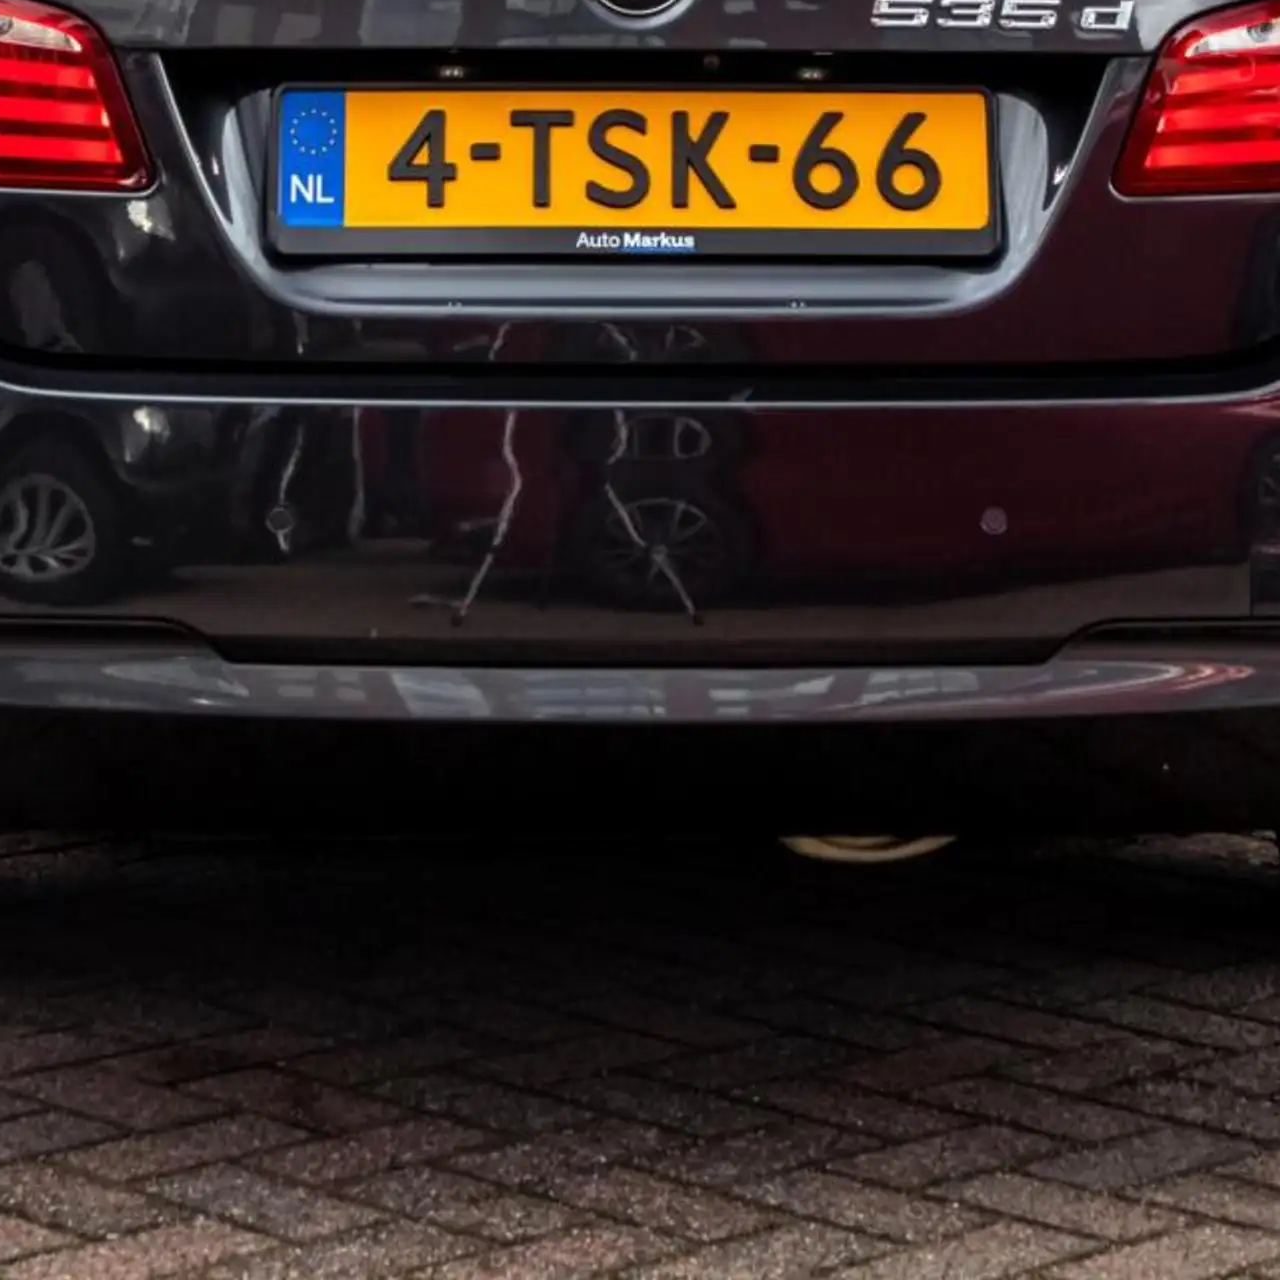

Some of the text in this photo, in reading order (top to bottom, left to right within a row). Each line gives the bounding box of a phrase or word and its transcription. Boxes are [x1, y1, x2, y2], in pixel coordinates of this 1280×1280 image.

[387, 109, 942, 211] 4-TSK-66
[290, 173, 335, 204] NL
[576, 231, 695, 248] Auto Markus
